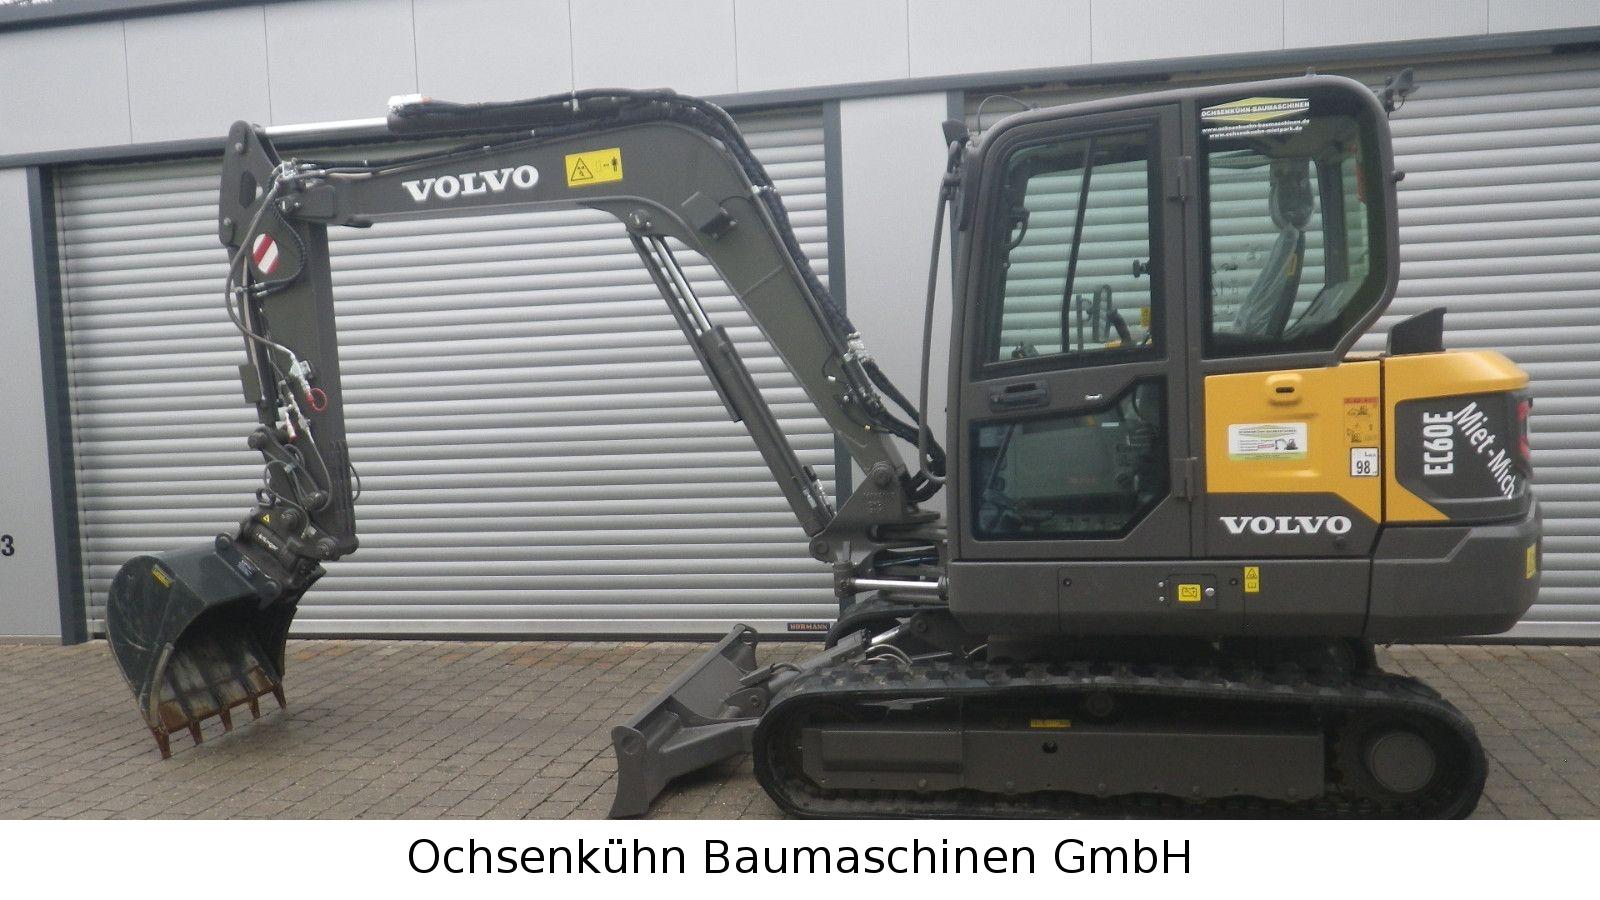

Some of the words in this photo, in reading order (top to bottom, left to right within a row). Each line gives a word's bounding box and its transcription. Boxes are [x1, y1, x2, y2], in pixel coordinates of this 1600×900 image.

[401, 164, 540, 202] VOLVO
[1423, 411, 1454, 475] EC60E
[1356, 460, 1371, 475] 98
[1220, 515, 1352, 535] VOLVO
[1, 534, 15, 557] 3
